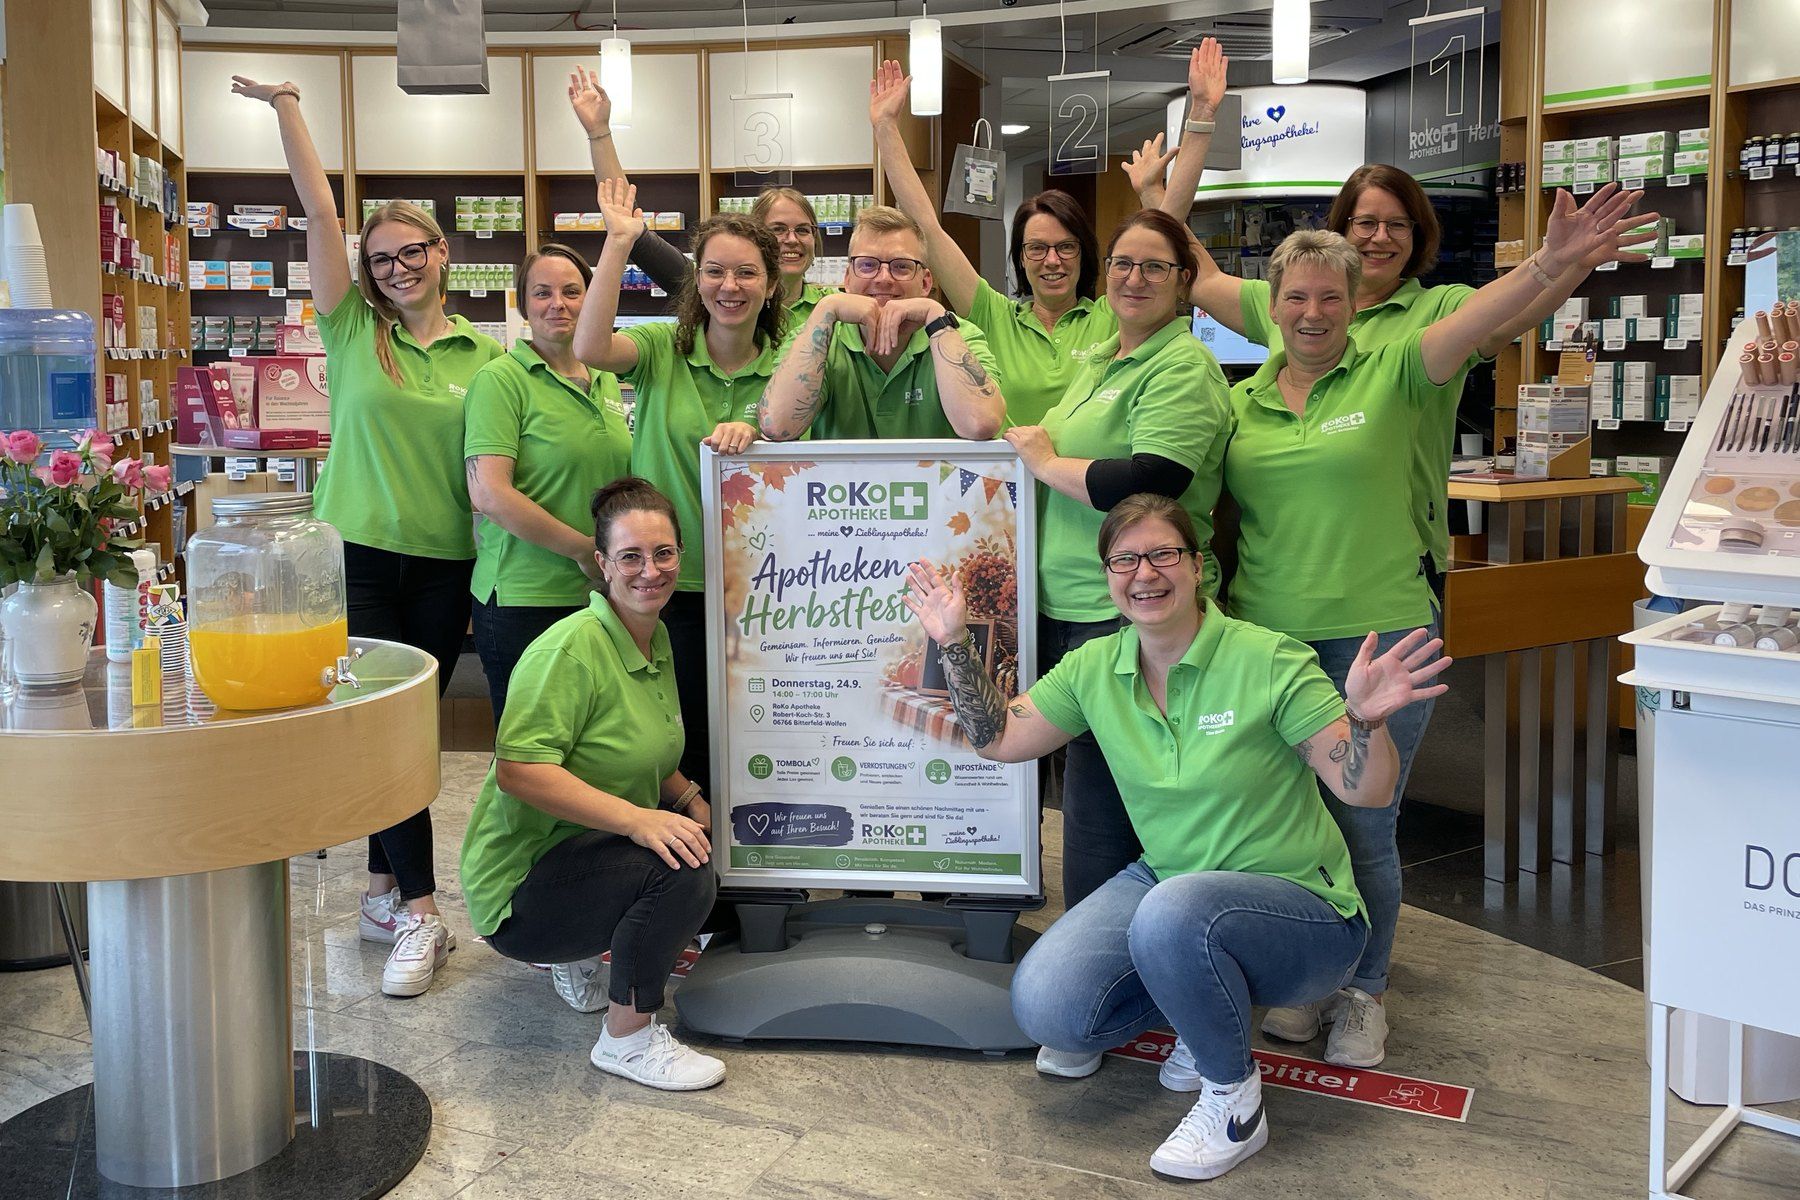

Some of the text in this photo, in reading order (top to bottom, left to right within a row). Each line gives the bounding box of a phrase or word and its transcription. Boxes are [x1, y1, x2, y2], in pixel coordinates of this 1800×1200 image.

[1429, 34, 1466, 117] 1
[1056, 93, 1100, 162] 2
[1240, 115, 1262, 129] hre
[743, 111, 784, 174] 3
[1240, 121, 1320, 152] lingsapotheke!
[1408, 145, 1442, 160] APOTHEKE
[807, 507, 888, 521] APOTHEKE
[855, 527, 929, 541] Lieblingsapotheke!
[739, 584, 914, 636] Herbstfest
[760, 633, 907, 652] Gemeinsam. Informieren. Genießen.
[785, 648, 877, 665] Wir freuen uns auf Sie!
[772, 678, 862, 690] Donnerstag, 24.9.
[772, 690, 794, 698] 14:00
[793, 719, 847, 727] Bitterfeld-Wolfen
[832, 735, 915, 750] Freuen Sie sich auf:
[860, 762, 907, 770] VERKOSTUNGEN
[954, 763, 997, 772] INFOSTÄNDE
[860, 803, 885, 811] Genießen
[934, 805, 965, 813] Nachmittag
[774, 812, 787, 822] Wir
[790, 811, 812, 822] freuen
[770, 820, 840, 836] auf Ihren Besuch!
[861, 838, 905, 846] APOTHEKE
[1743, 900, 1766, 913] DAS
[1254, 1058, 1360, 1092] bitte!
